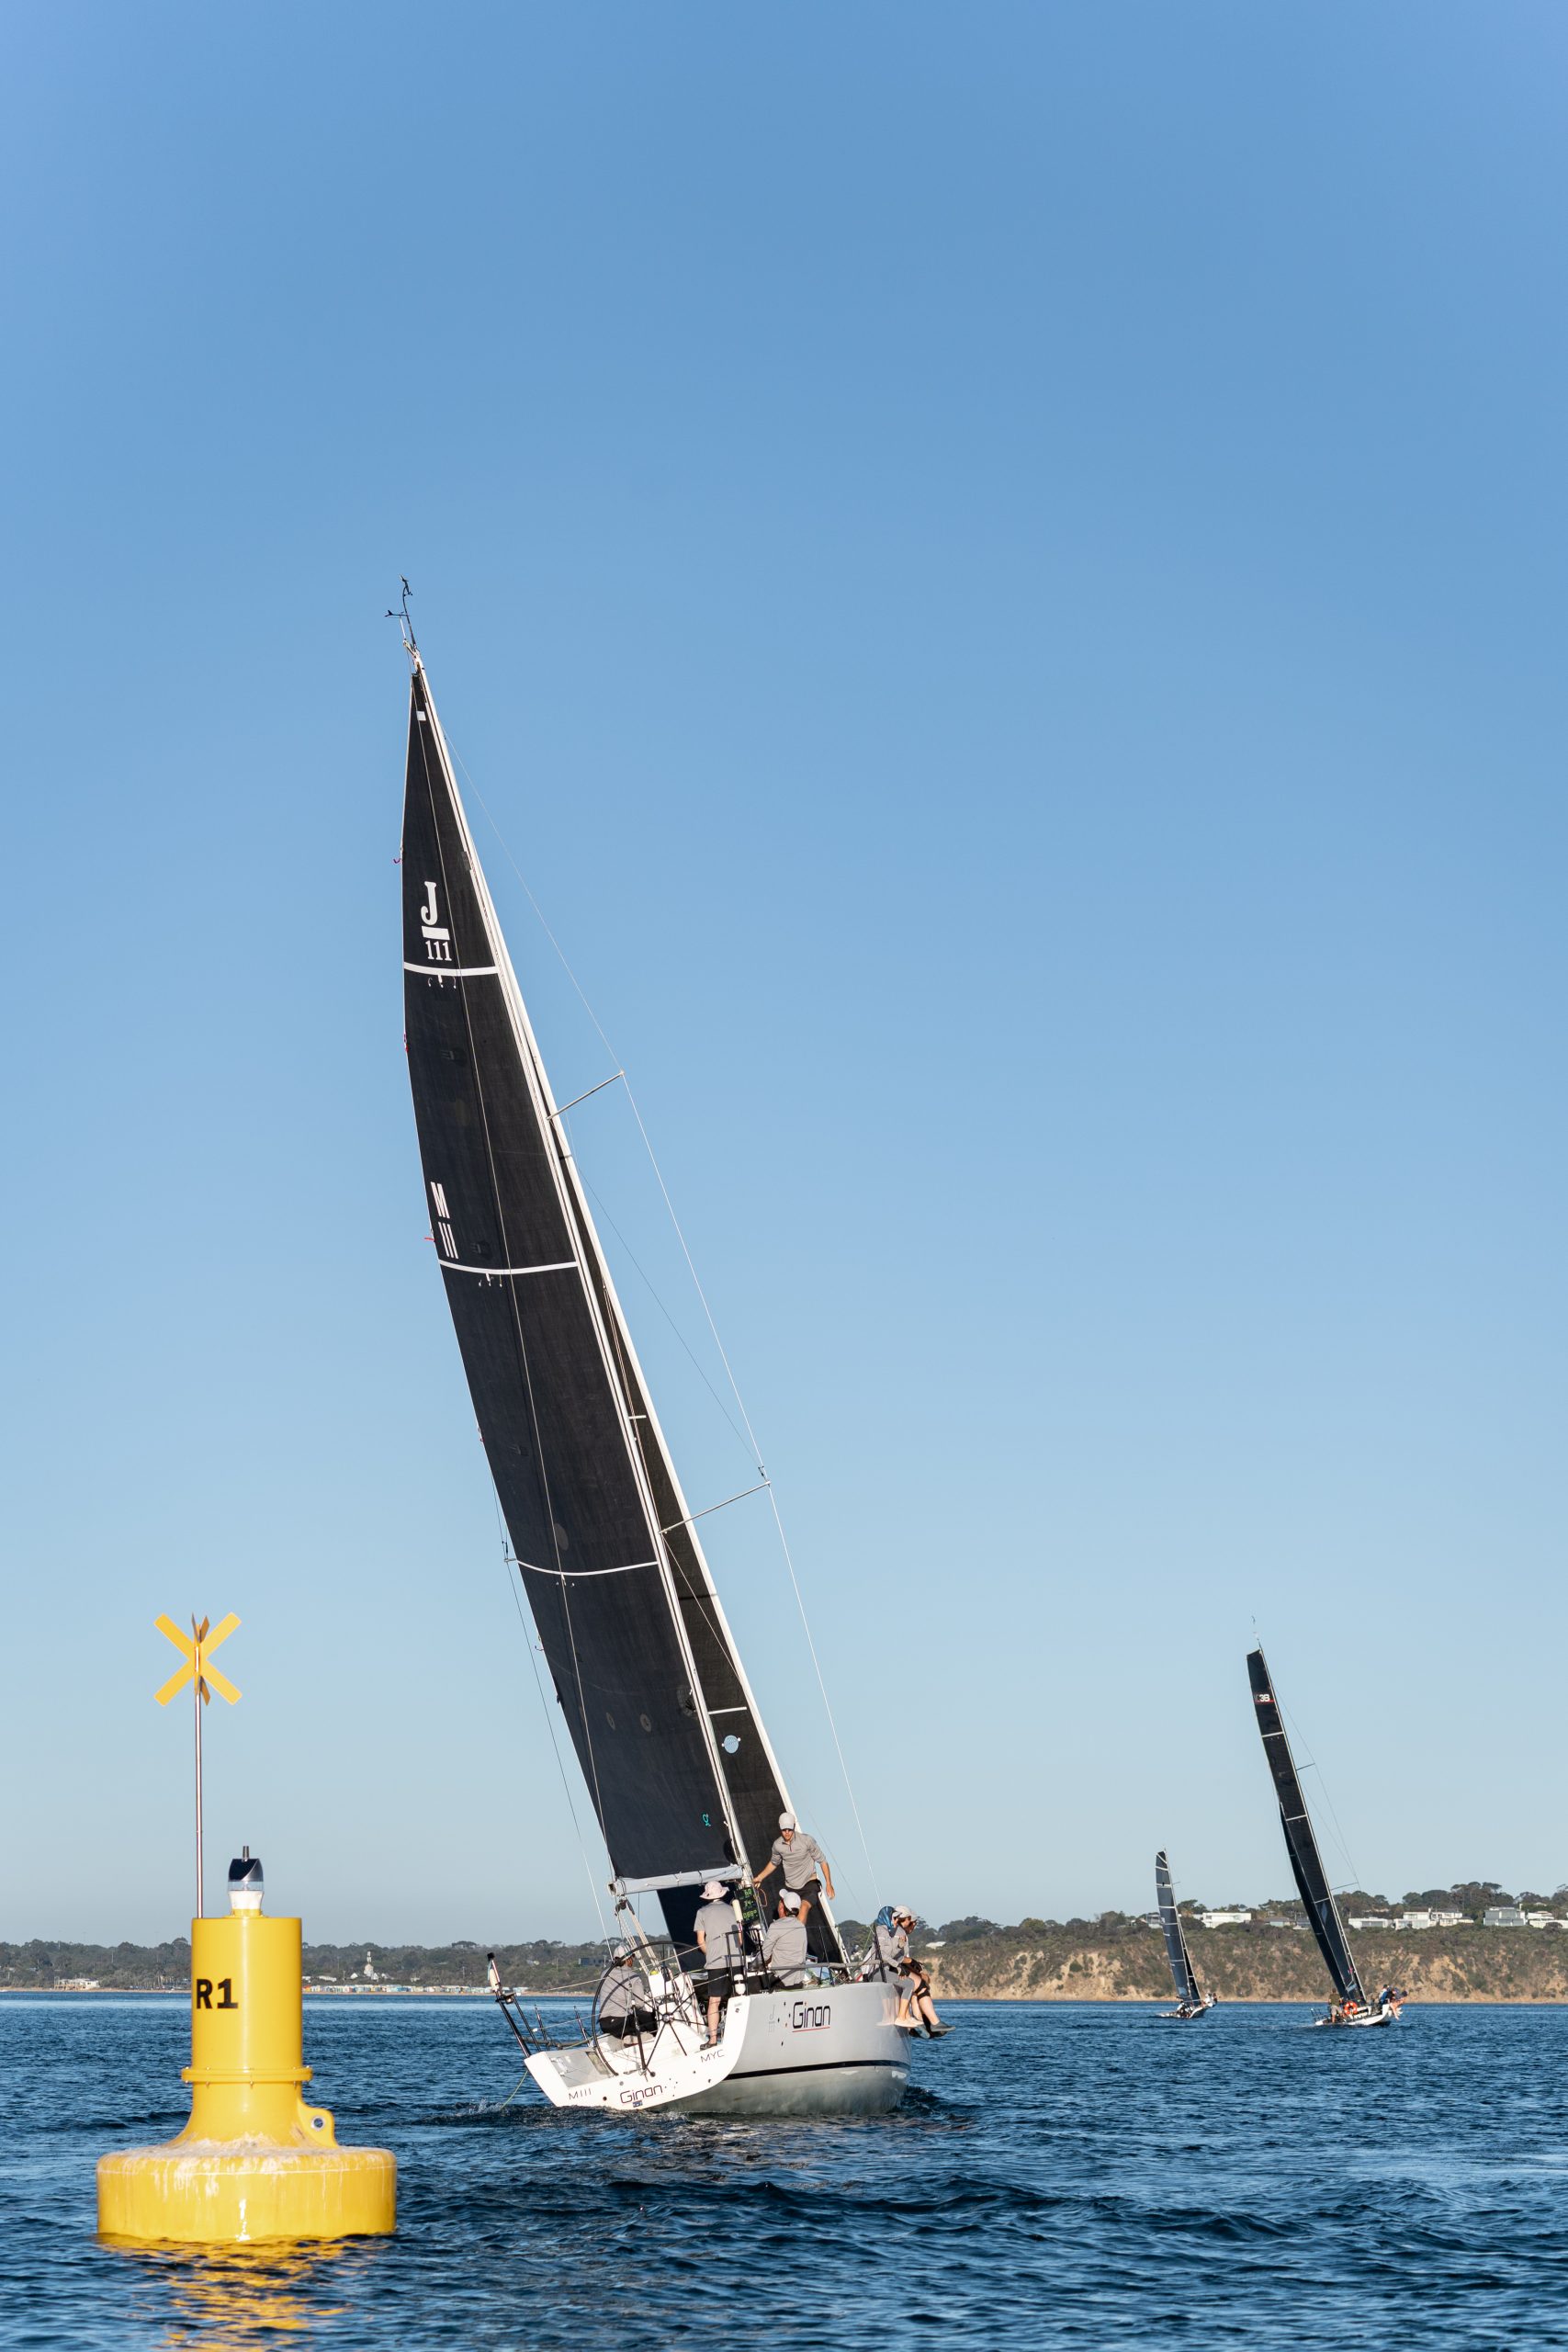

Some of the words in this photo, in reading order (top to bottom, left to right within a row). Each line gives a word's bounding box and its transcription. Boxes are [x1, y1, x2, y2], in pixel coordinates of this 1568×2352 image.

[420, 880, 438, 926] J
[425, 940, 452, 961] 111
[196, 1978, 238, 2009] R1
[792, 2001, 831, 2029] Ginan
[700, 2049, 725, 2064] MYC
[619, 2085, 663, 2104] Ginan
